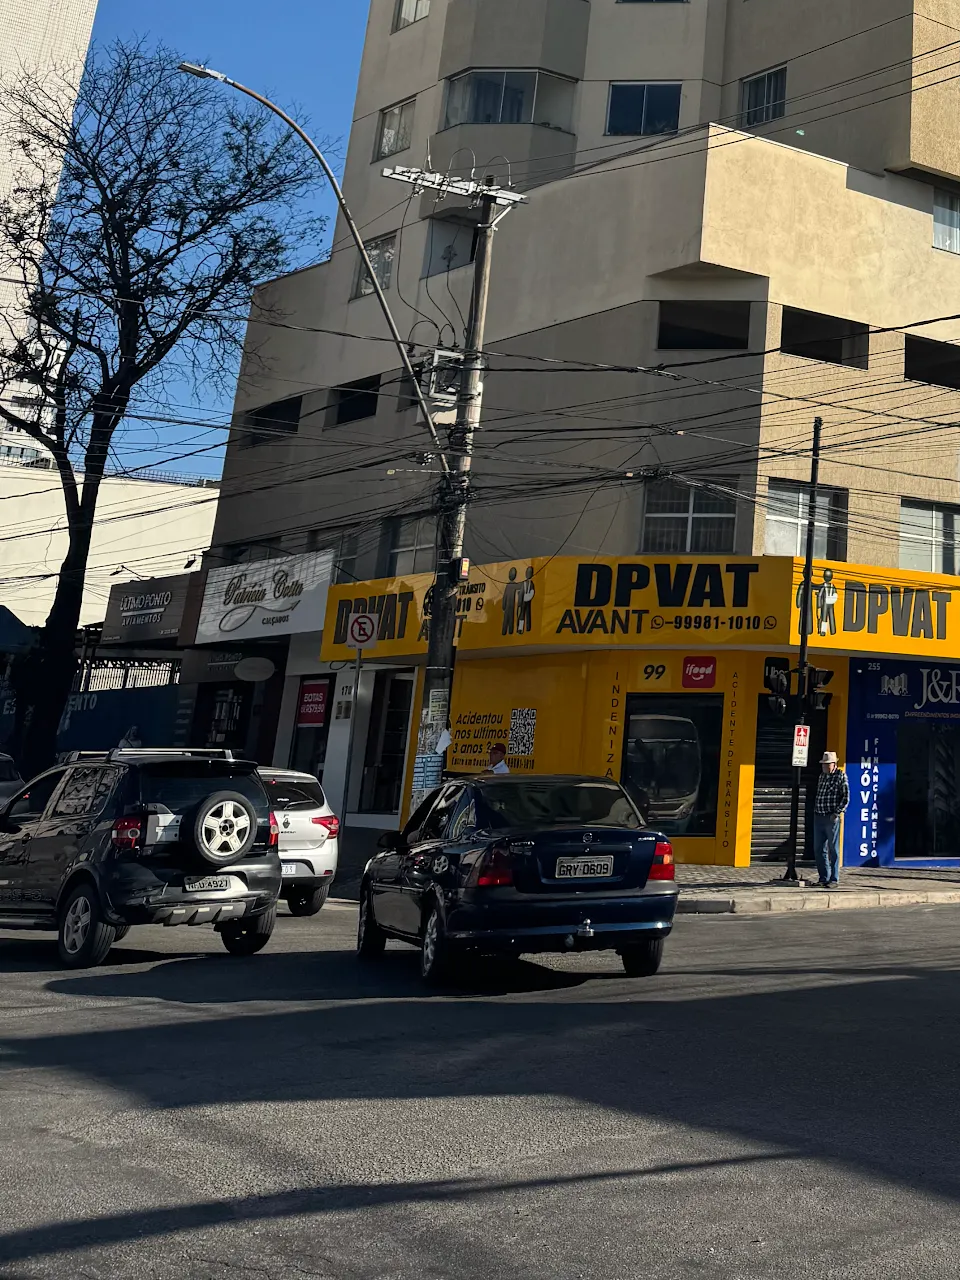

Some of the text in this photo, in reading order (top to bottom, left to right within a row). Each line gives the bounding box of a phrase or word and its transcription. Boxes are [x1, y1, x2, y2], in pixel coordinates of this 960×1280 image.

[574, 563, 759, 607] DPVAT
[146, 590, 171, 606] PONTO
[843, 581, 951, 640] DPVAT
[121, 613, 162, 627] AVIAMENTOS
[556, 609, 650, 635] AVANT
[643, 664, 666, 680] 99
[867, 662, 881, 670] 255
[456, 711, 503, 725] Acidentou
[454, 725, 509, 740] nos ultimos
[452, 742, 458, 754] 3
[460, 743, 483, 754] anos
[859, 739, 871, 857] IMÓVEIS
[871, 738, 879, 858] FINANCIAMENTO
